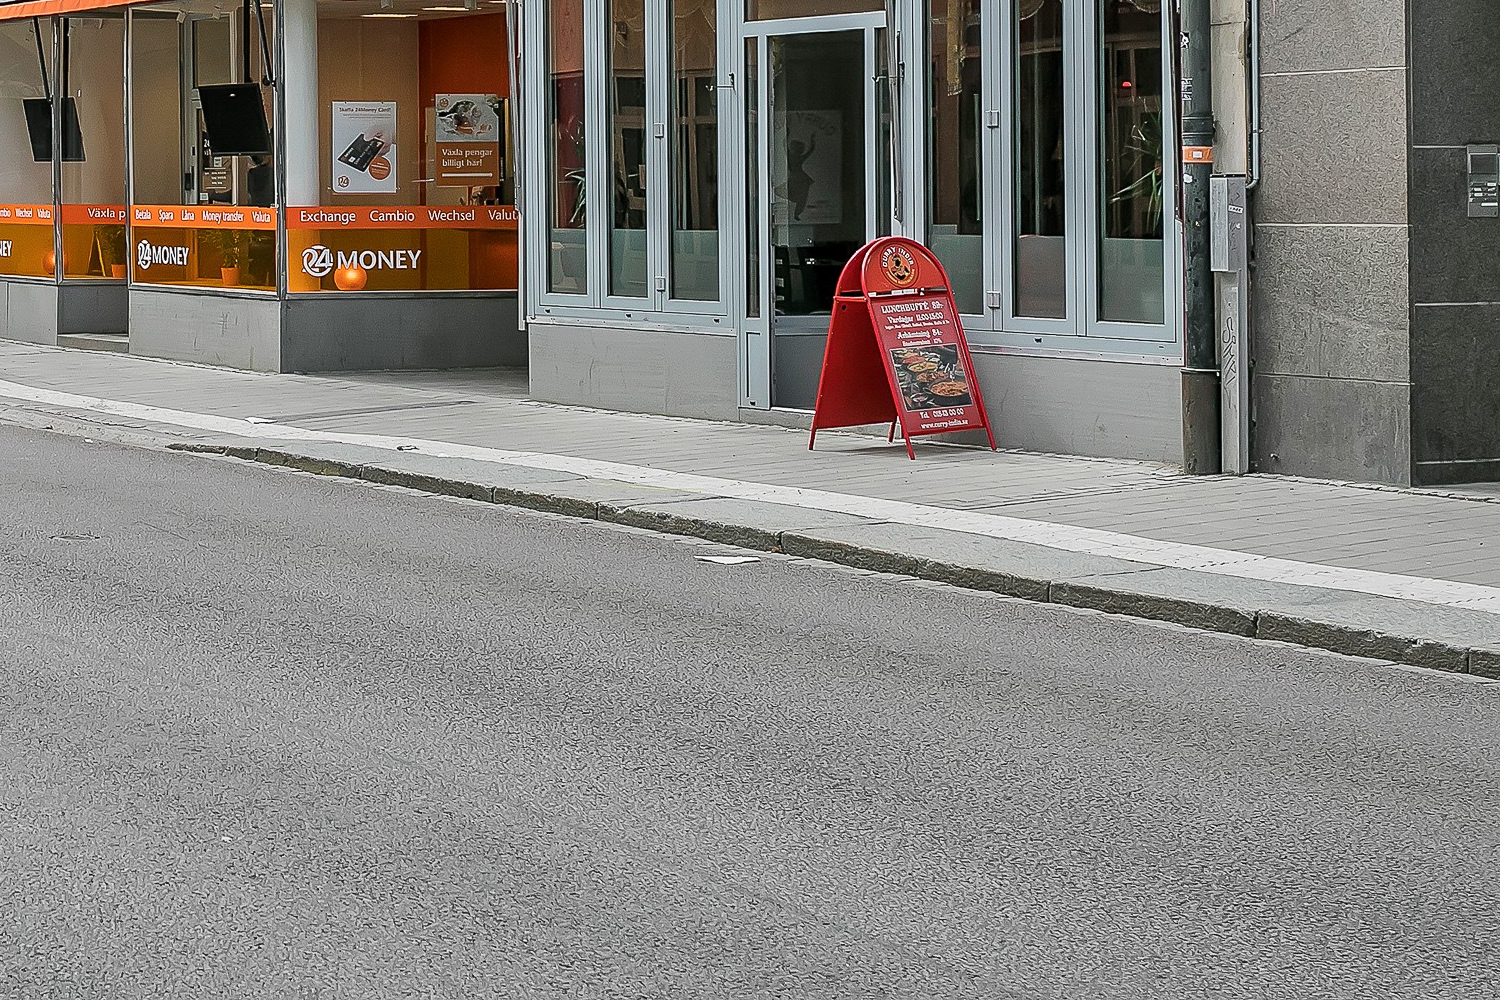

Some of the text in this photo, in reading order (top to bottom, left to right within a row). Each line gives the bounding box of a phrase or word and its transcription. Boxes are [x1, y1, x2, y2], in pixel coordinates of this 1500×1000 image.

[465, 150, 493, 158] pengar
[442, 159, 465, 168] billigt
[88, 207, 116, 219] Växla
[158, 209, 174, 223] Spara
[181, 208, 195, 221] Låna
[202, 210, 223, 224] Money
[252, 211, 271, 223] Valuta
[300, 210, 356, 224] Exchange
[369, 210, 415, 222] Cambio
[428, 210, 475, 221] Wechsel
[152, 246, 189, 266] MONEY
[337, 249, 421, 270] MONEY
